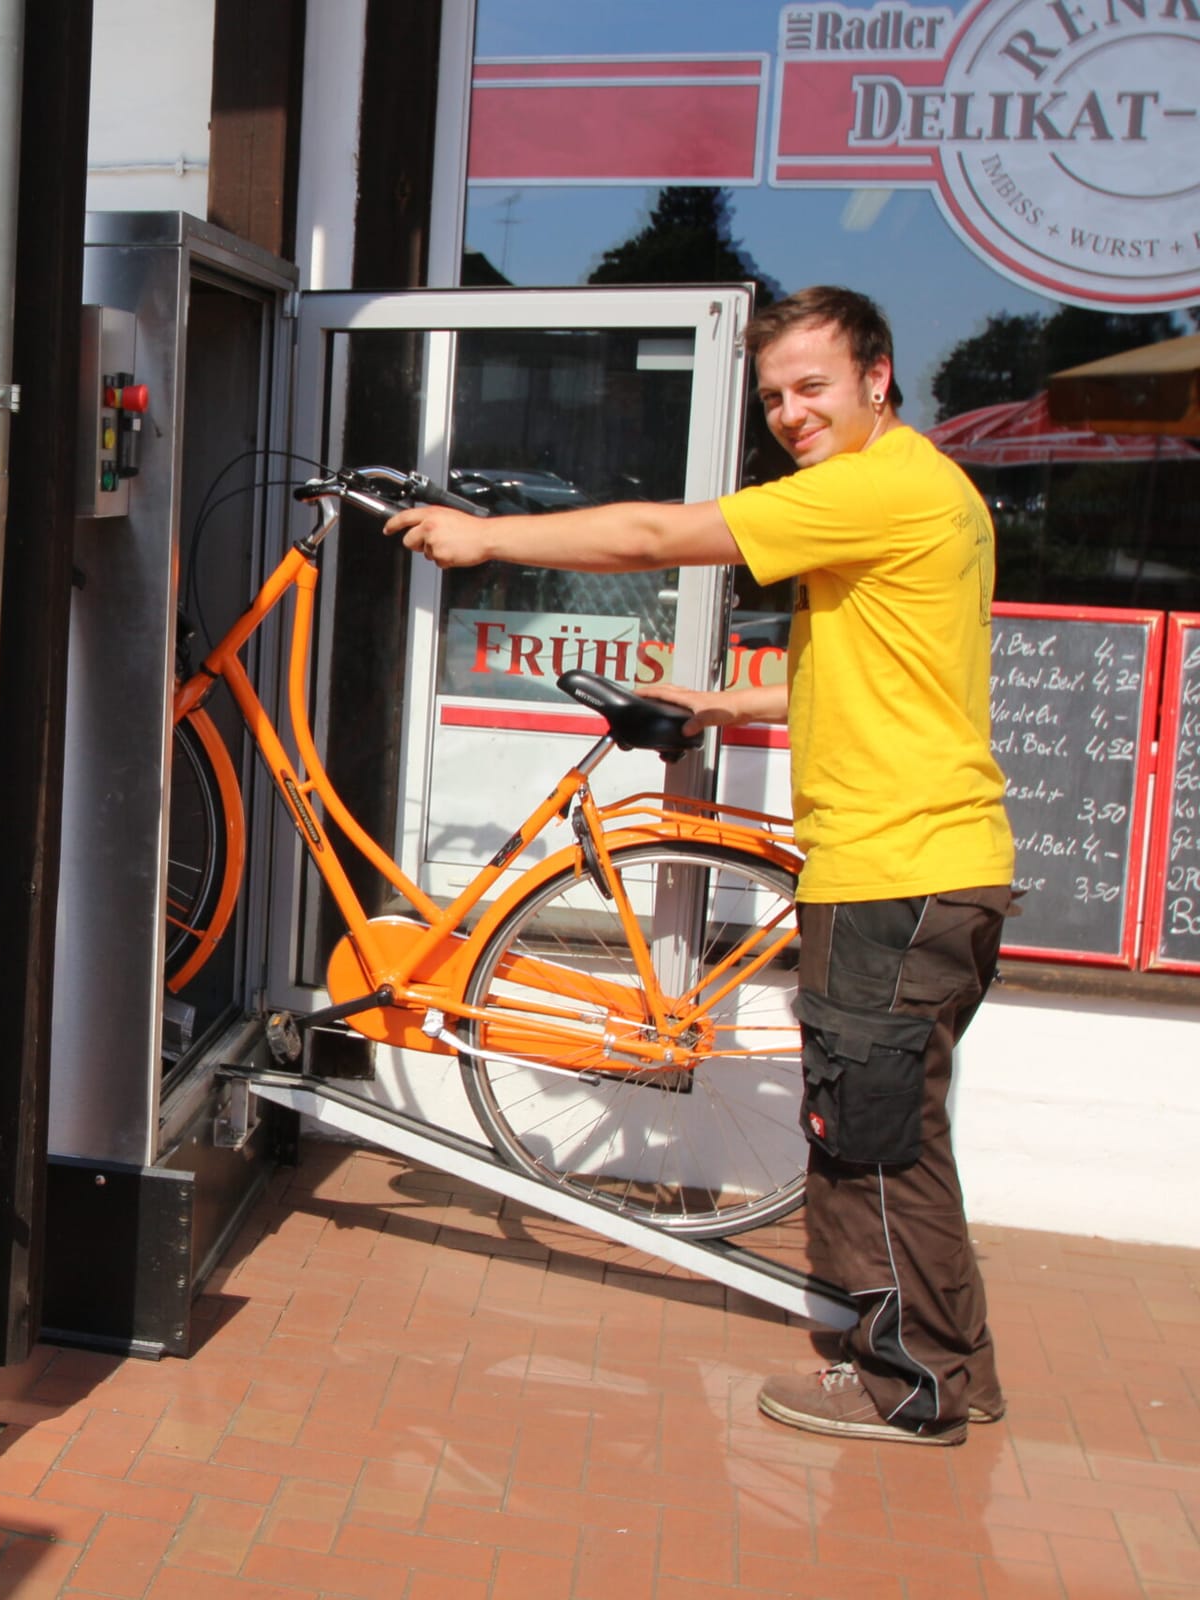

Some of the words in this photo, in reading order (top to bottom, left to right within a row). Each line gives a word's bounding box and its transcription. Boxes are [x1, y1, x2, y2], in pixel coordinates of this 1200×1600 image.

[786, 12, 813, 50] DIE
[816, 10, 944, 50] Radler
[853, 79, 1197, 142] DELIKAT-
[981, 153, 1044, 225] IMBISS
[1071, 227, 1160, 257] WURST
